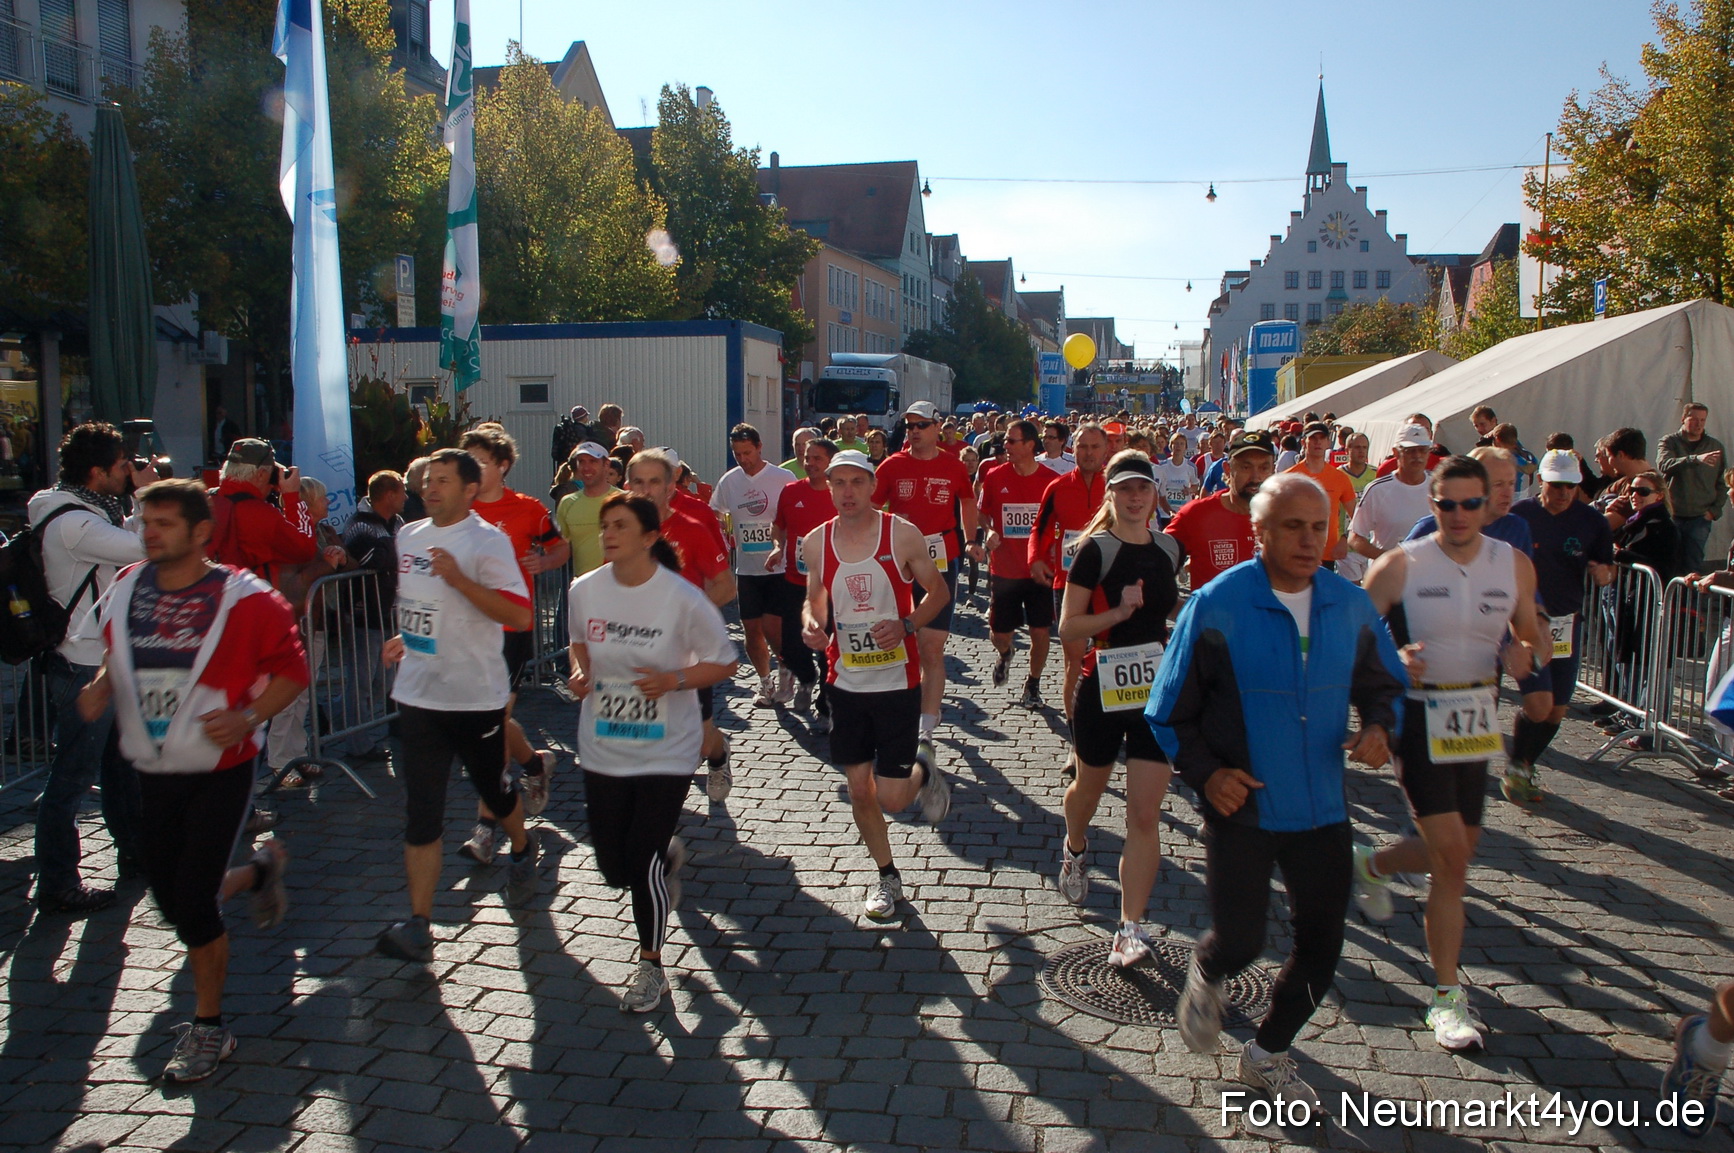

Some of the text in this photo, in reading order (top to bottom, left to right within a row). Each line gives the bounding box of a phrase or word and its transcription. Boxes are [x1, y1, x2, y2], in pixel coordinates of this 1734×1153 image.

[400, 260, 410, 288] P
[1597, 284, 1604, 310] P
[1260, 329, 1294, 348] maxi
[1007, 513, 1037, 526] 3085
[743, 529, 771, 543] 3439
[929, 545, 938, 560] 6
[849, 632, 884, 653] 54
[851, 651, 896, 664] Andreas
[1115, 661, 1155, 687] 605
[600, 694, 657, 721] 3238
[1445, 708, 1490, 736] 474
